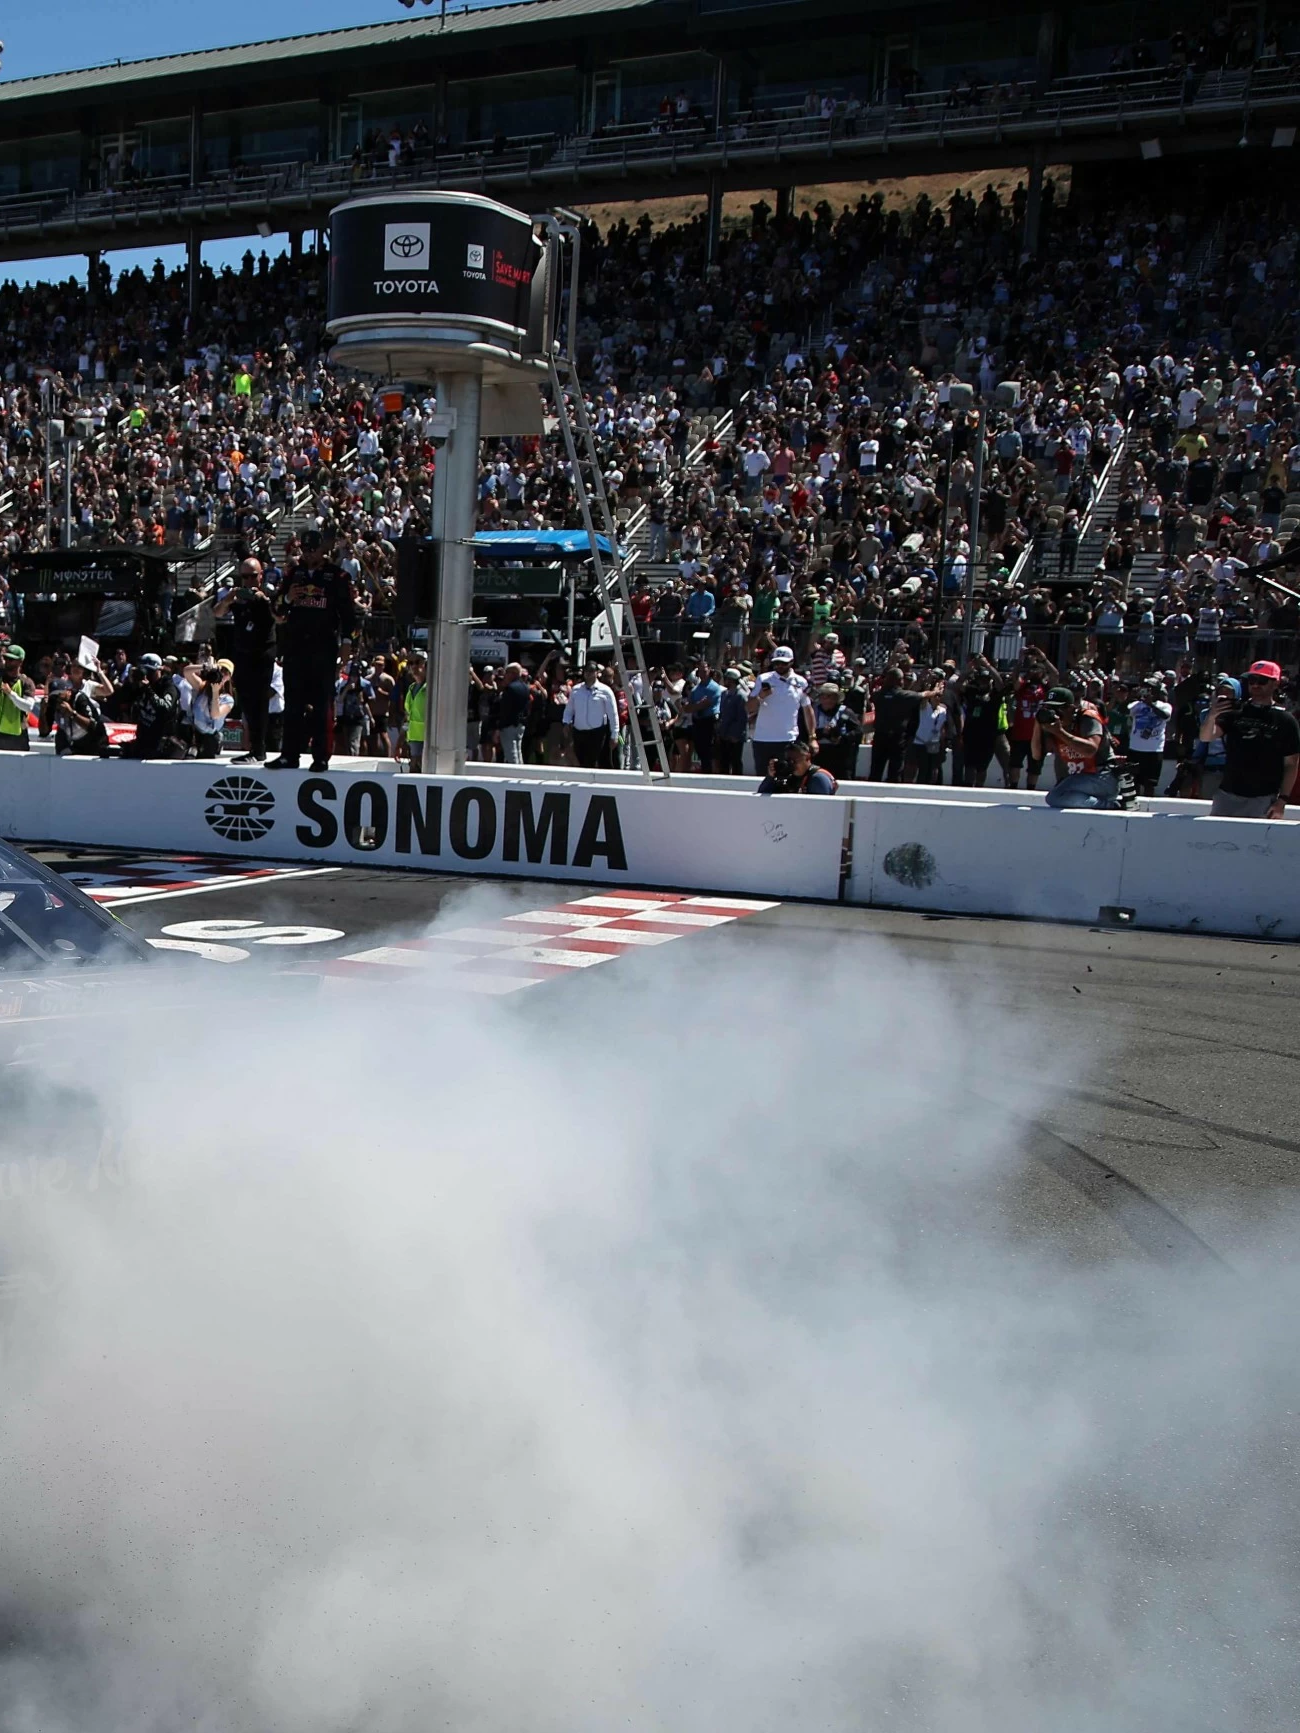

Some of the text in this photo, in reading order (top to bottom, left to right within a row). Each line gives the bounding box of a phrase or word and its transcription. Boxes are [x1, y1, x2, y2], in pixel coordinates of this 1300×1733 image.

[463, 270, 487, 280] TOYOTA
[373, 280, 439, 294] TOYOTA
[53, 569, 113, 582] MONSTER
[296, 777, 628, 871] SONOMA
